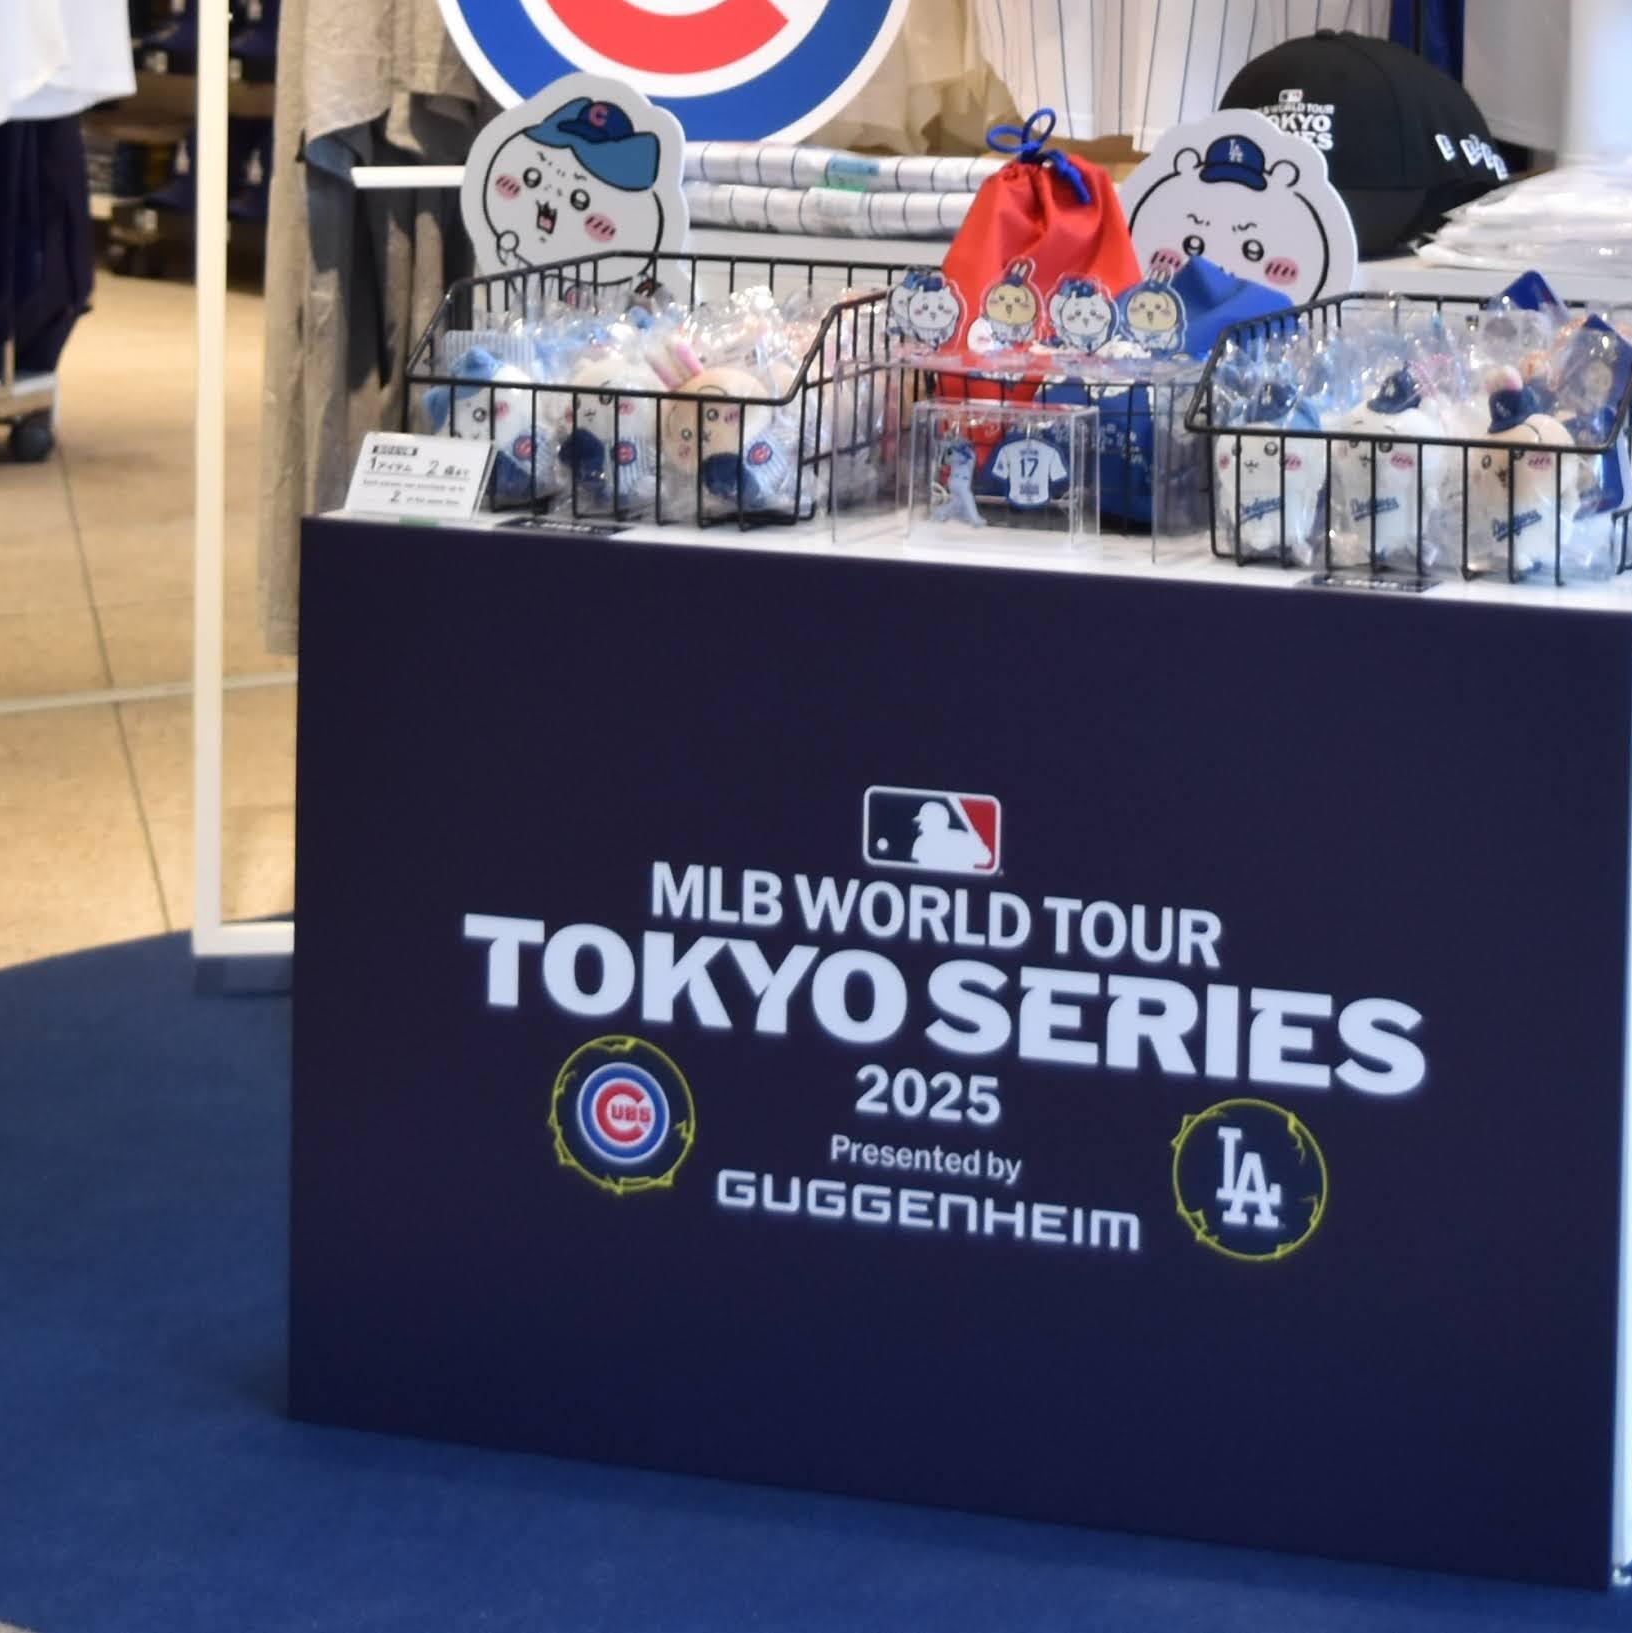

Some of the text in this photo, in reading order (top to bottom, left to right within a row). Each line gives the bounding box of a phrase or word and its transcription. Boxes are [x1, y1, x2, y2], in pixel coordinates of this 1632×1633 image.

[1267, 113, 1333, 133] OKYO
[1019, 457, 1039, 479] 17
[651, 860, 1224, 968] MLB WORLD TOUR
[463, 912, 1429, 1097] TOKYO SERIES
[854, 1063, 1004, 1127] 2025
[830, 1134, 1023, 1186] Presented by
[1215, 1125, 1283, 1230] LA
[714, 1167, 1143, 1252] GUGGENHEIM
